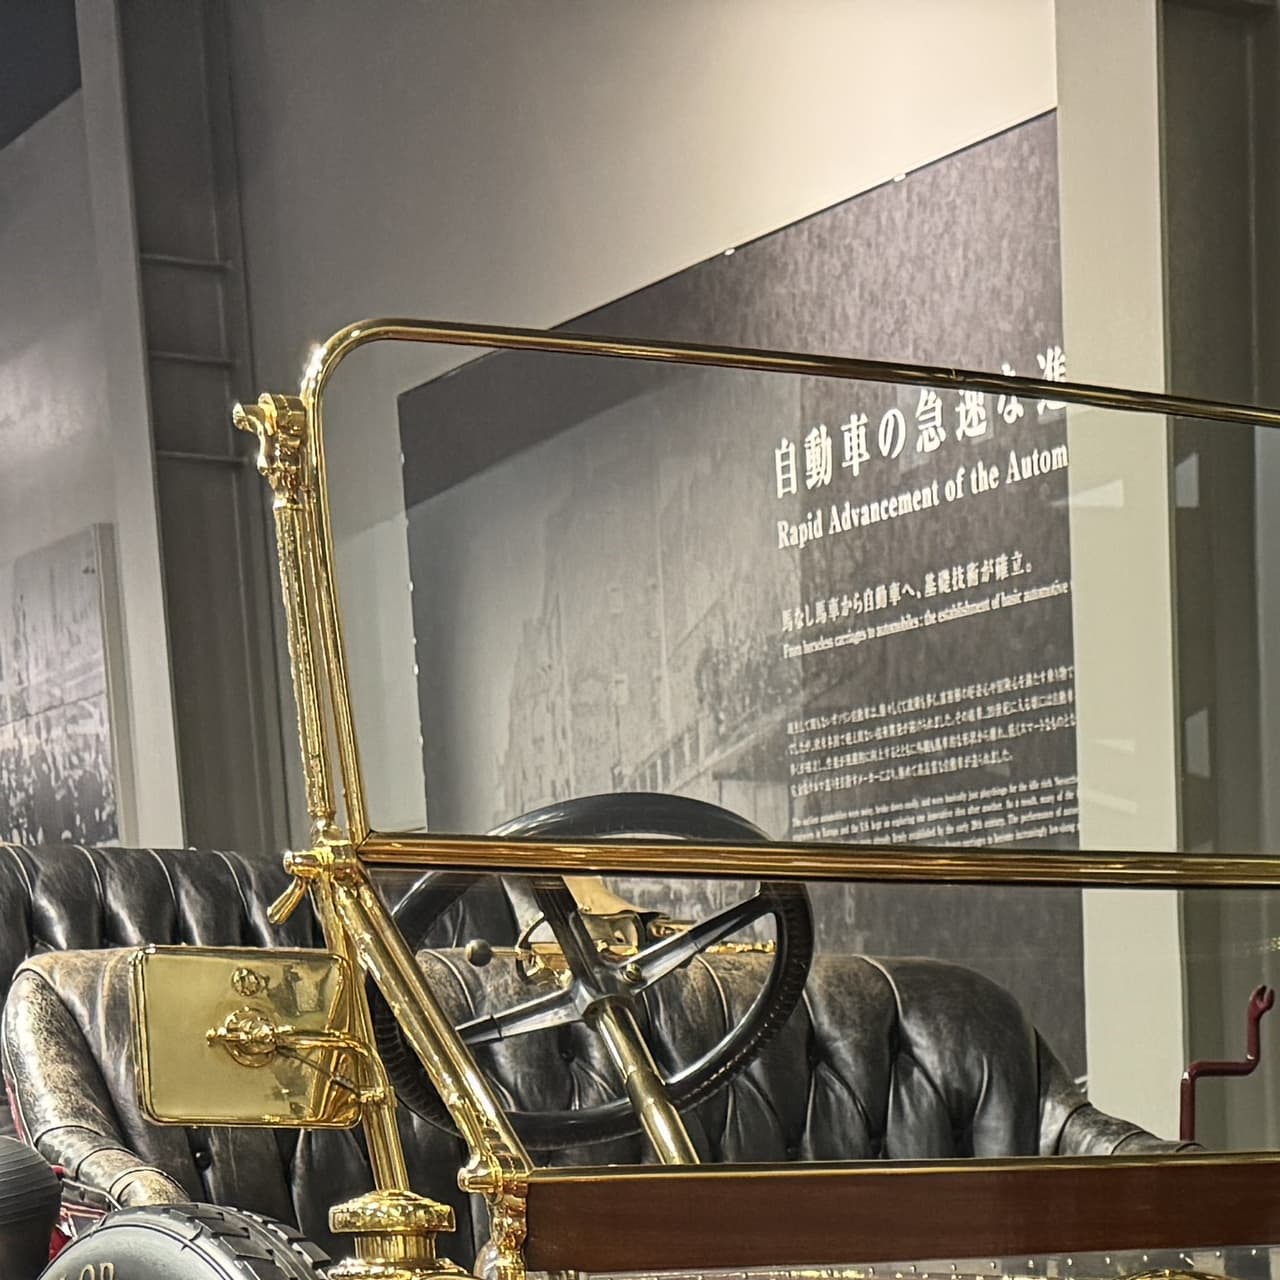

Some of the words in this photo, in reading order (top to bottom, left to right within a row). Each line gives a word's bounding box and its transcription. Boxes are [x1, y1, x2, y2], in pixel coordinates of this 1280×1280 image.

[776, 509, 823, 549] Rapid
[828, 479, 940, 535] Advancement
[944, 467, 966, 502] of
[970, 460, 1000, 495] the
